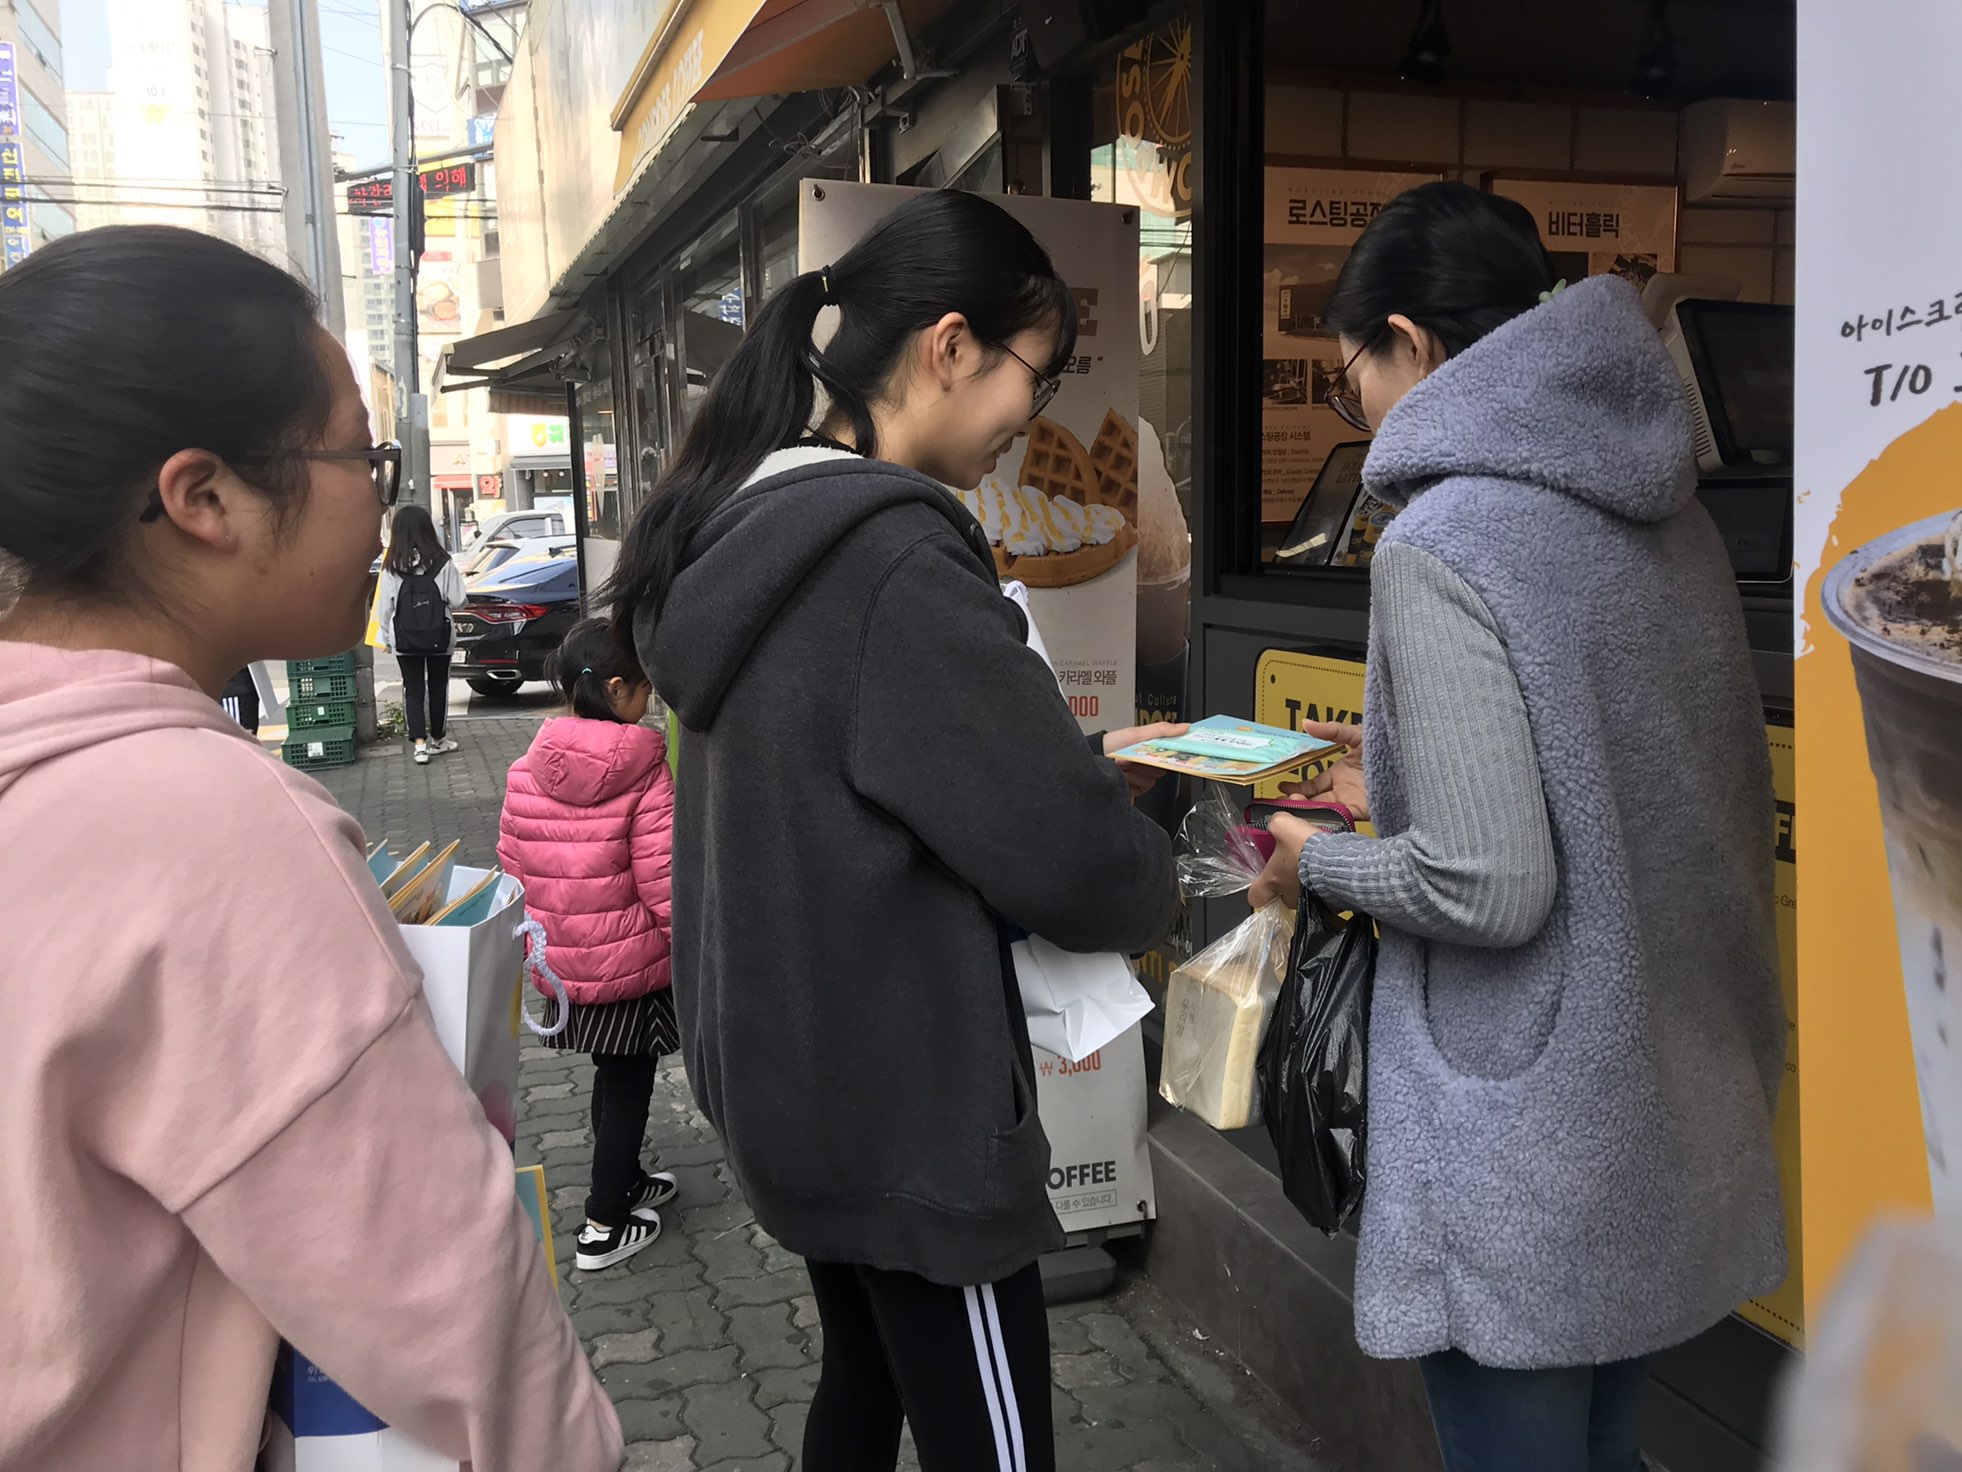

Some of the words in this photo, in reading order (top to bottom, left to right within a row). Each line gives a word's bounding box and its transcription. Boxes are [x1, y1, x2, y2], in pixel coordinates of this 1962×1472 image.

[146, 86, 165, 97] 103
[1548, 211, 1620, 239] 비터홀릭
[1864, 364, 1932, 407] T/O
[1059, 670, 1092, 685] 카라멜
[1093, 670, 1118, 685] 와플
[1073, 1199, 1080, 1208] 수
